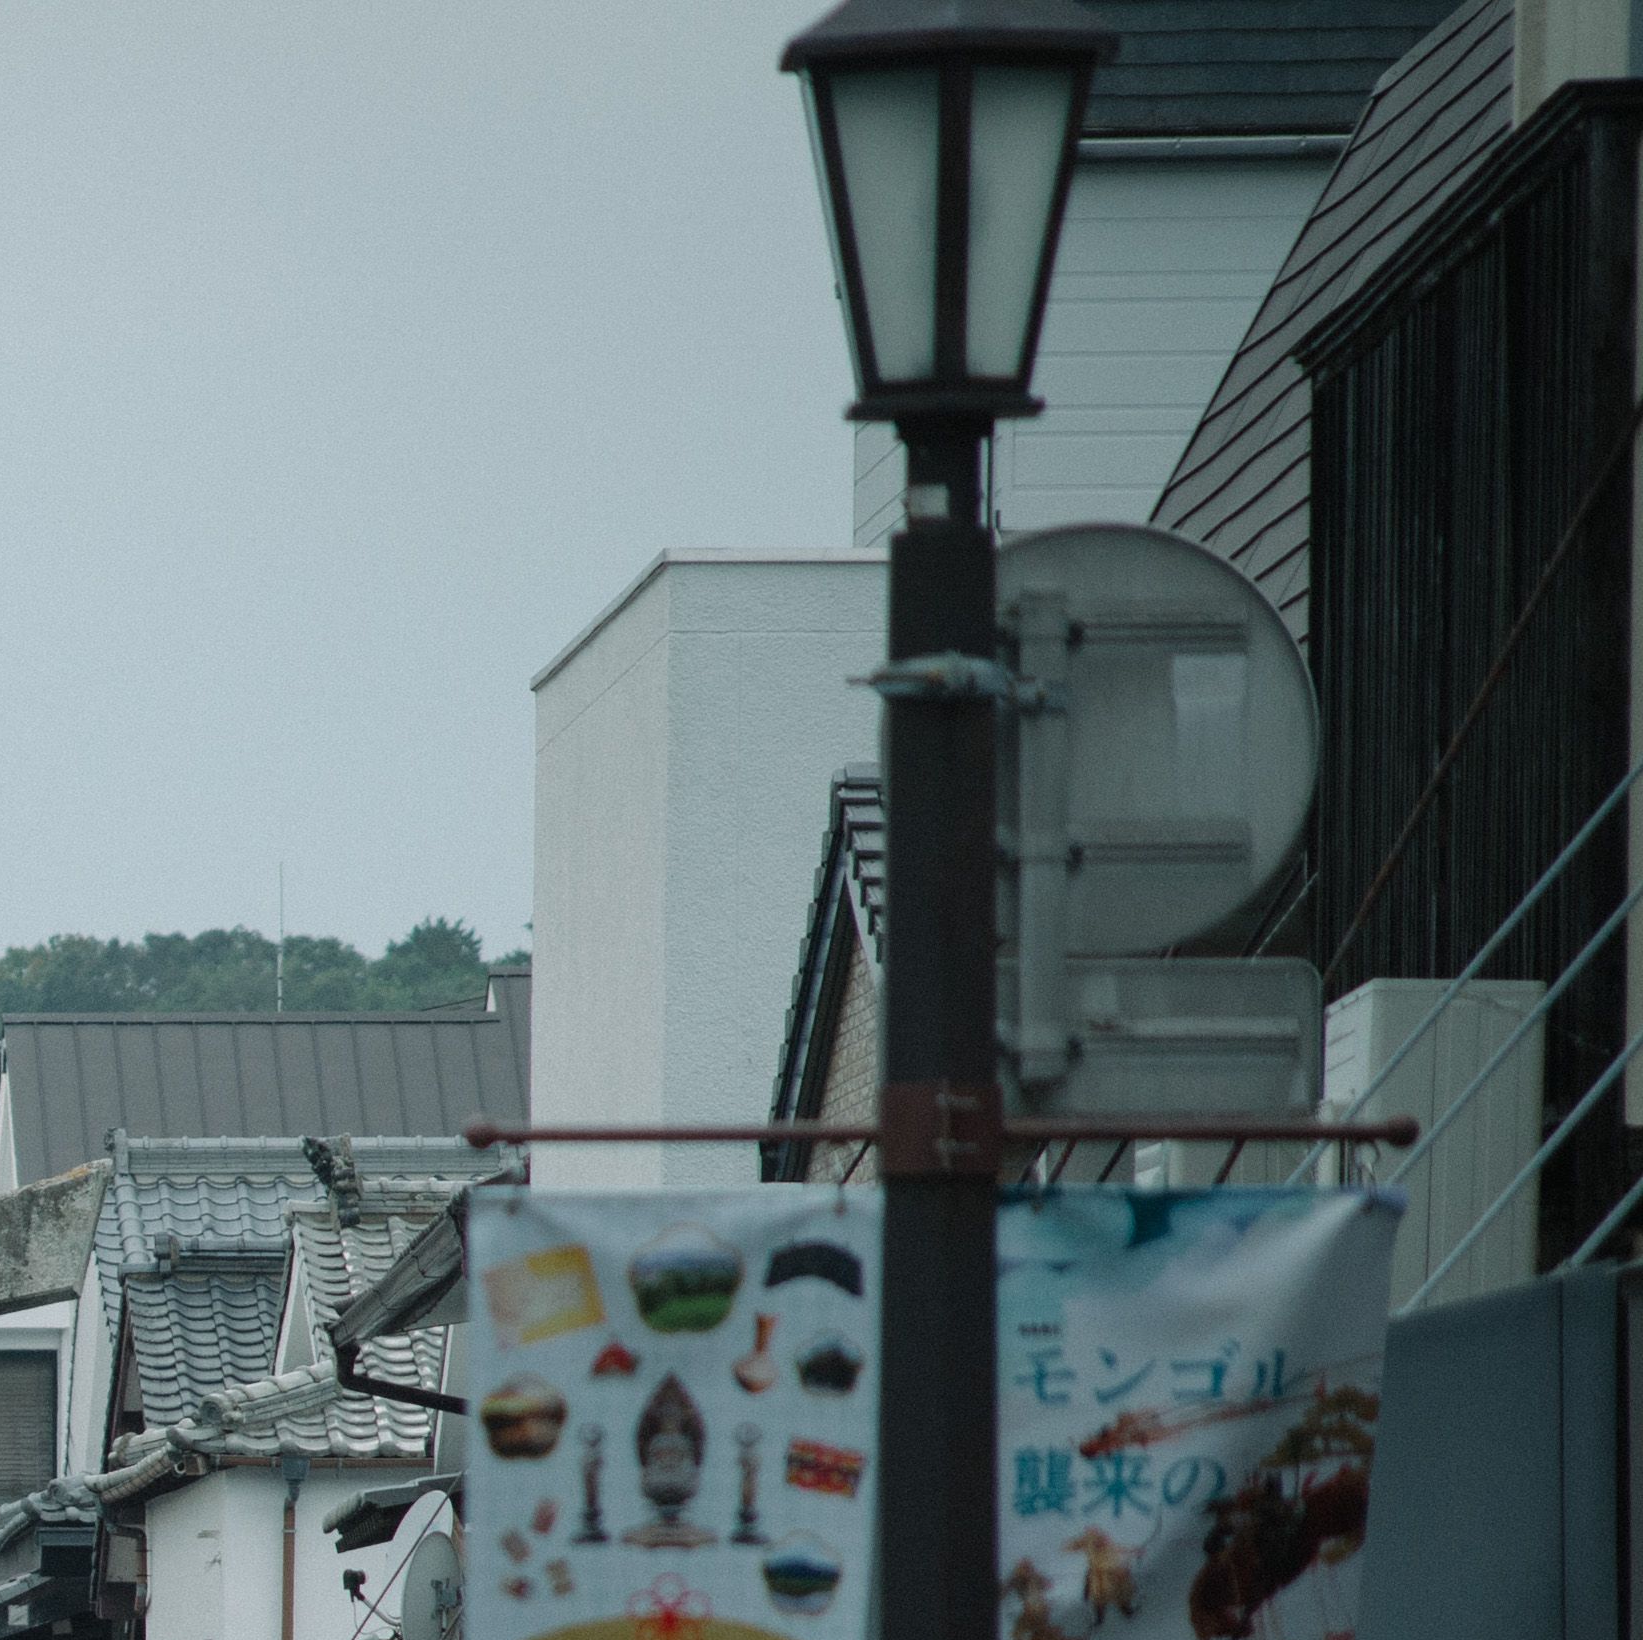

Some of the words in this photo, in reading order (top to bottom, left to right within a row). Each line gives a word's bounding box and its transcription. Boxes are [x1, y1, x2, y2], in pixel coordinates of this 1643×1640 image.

[1015, 1338, 1307, 1403] モンゴル
[1015, 1446, 1226, 1518] 襲来の
